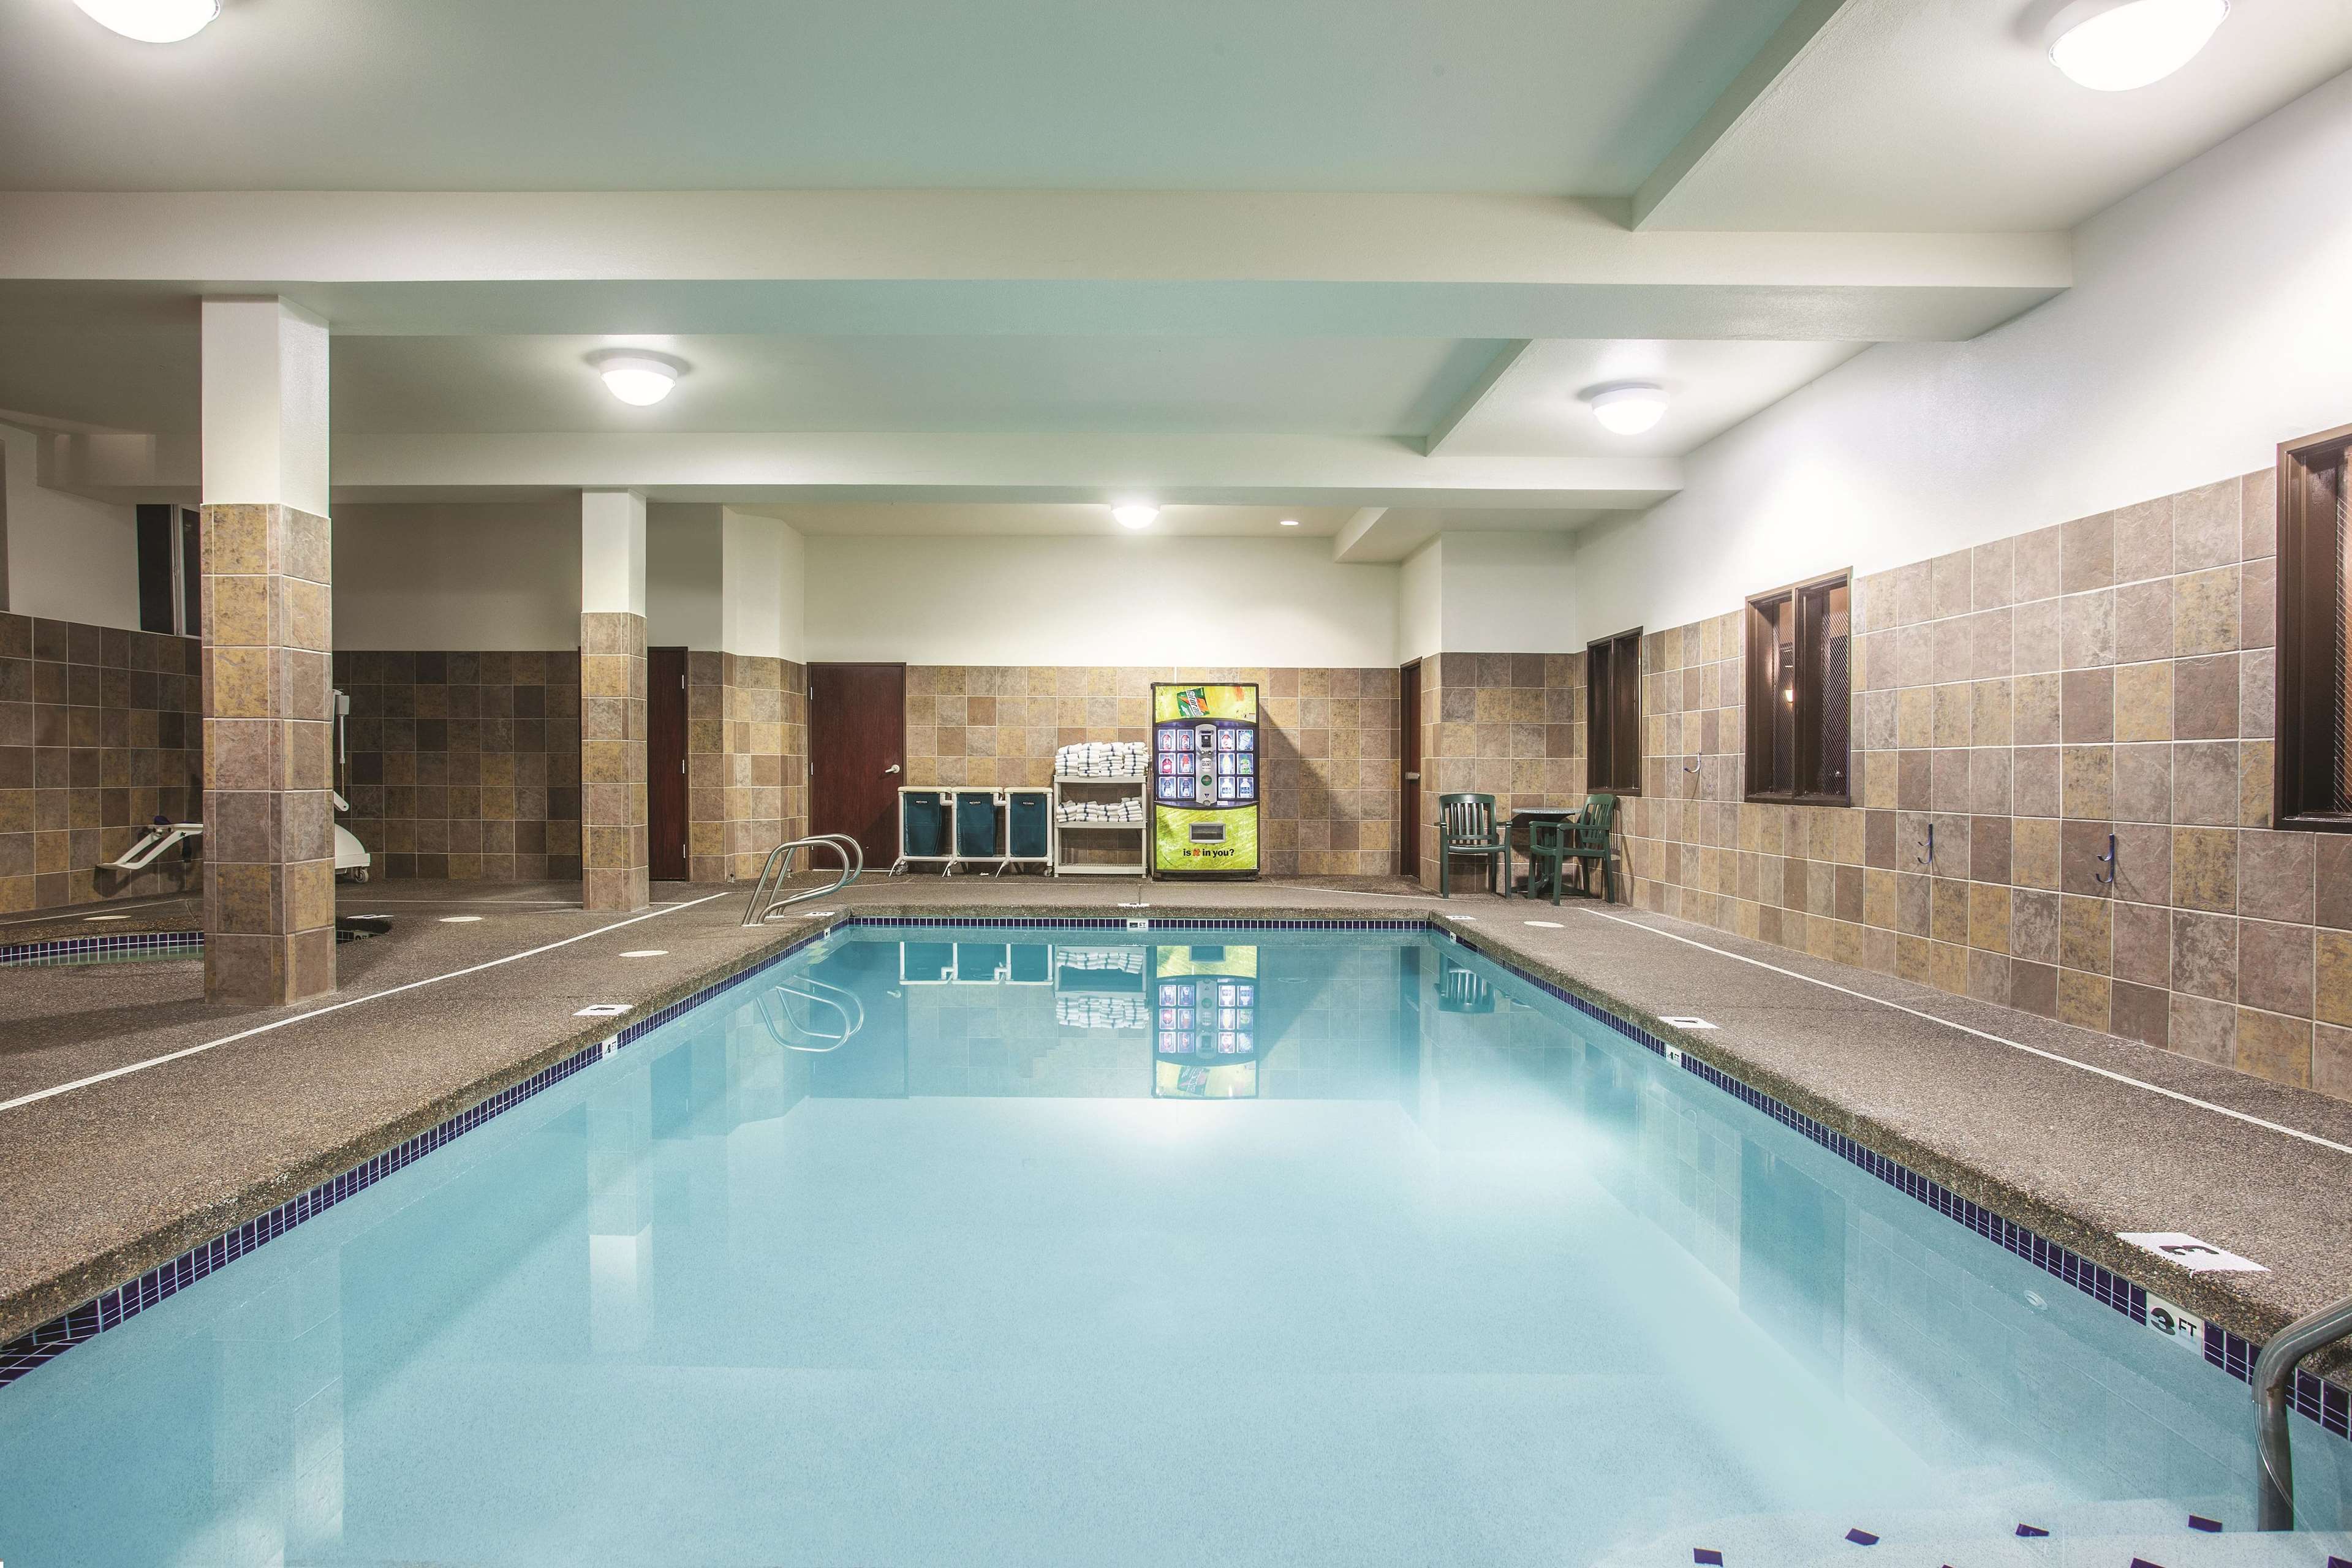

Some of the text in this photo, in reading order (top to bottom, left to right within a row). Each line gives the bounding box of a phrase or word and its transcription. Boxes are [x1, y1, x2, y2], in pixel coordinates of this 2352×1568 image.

[1212, 848, 1235, 858] you?
[2150, 1307, 2198, 1337] 3 FT
